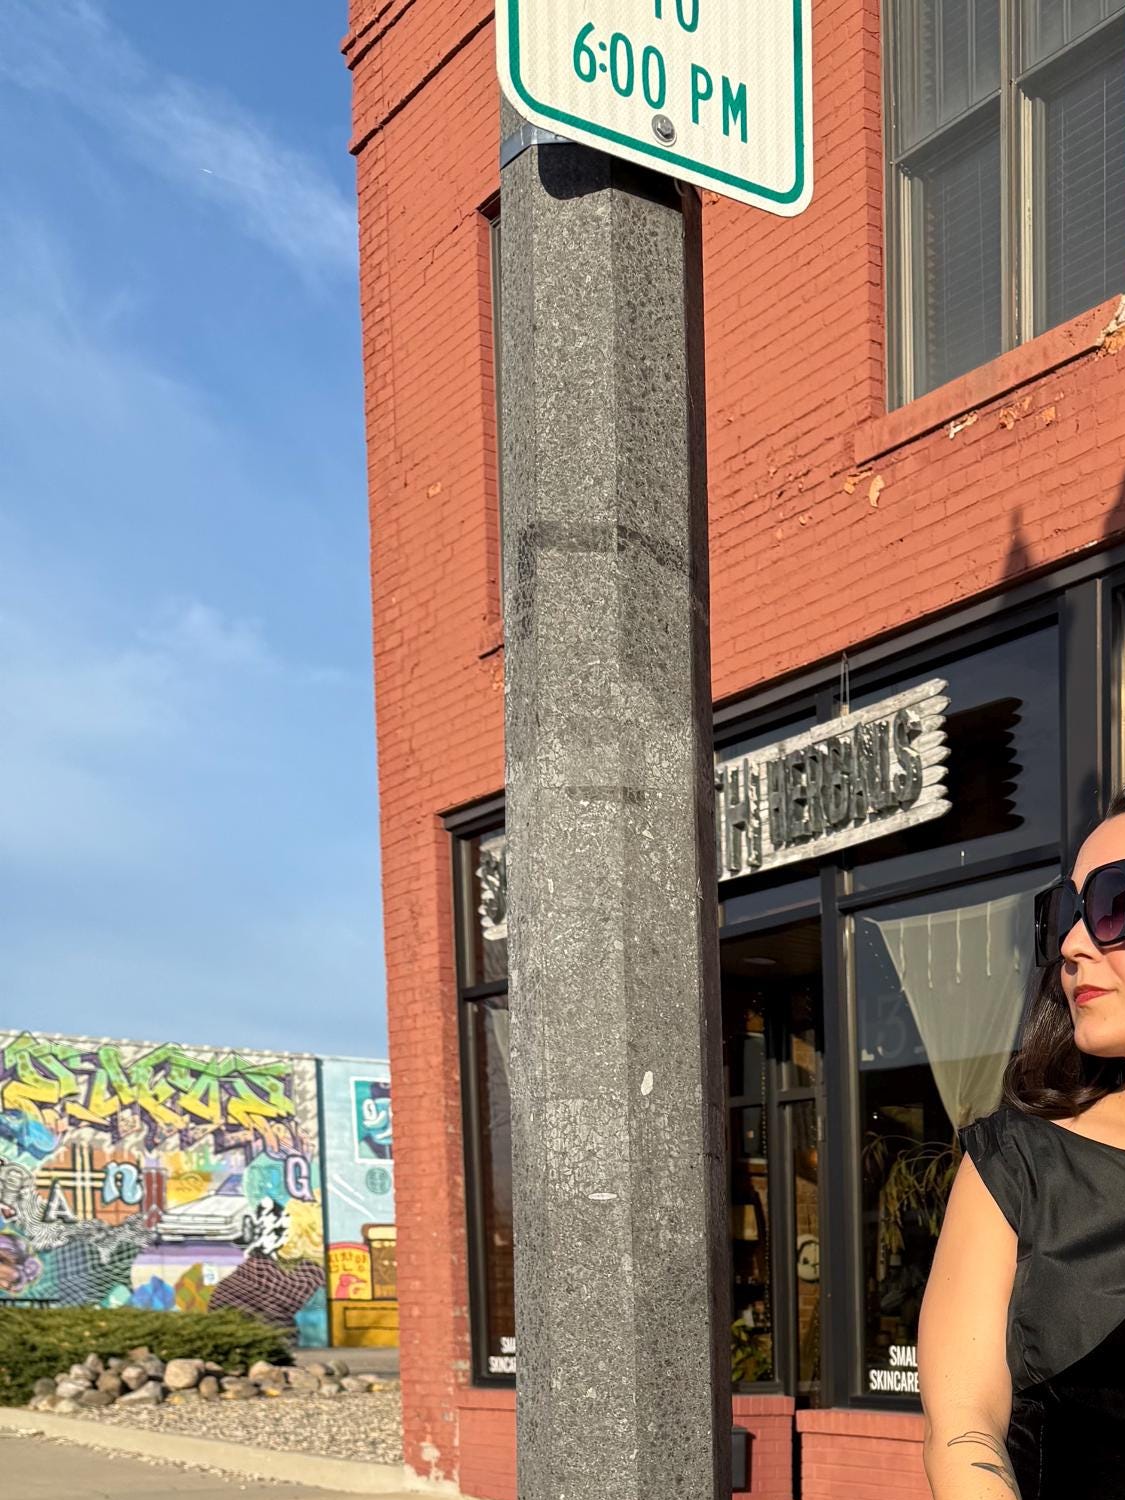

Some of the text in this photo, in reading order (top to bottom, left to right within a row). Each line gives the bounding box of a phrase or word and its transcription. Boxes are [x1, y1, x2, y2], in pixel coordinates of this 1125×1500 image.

[573, 22, 748, 144] 6:00 PM
[767, 710, 924, 848] HERBALS
[868, 1369, 921, 1393] SKINCARE
